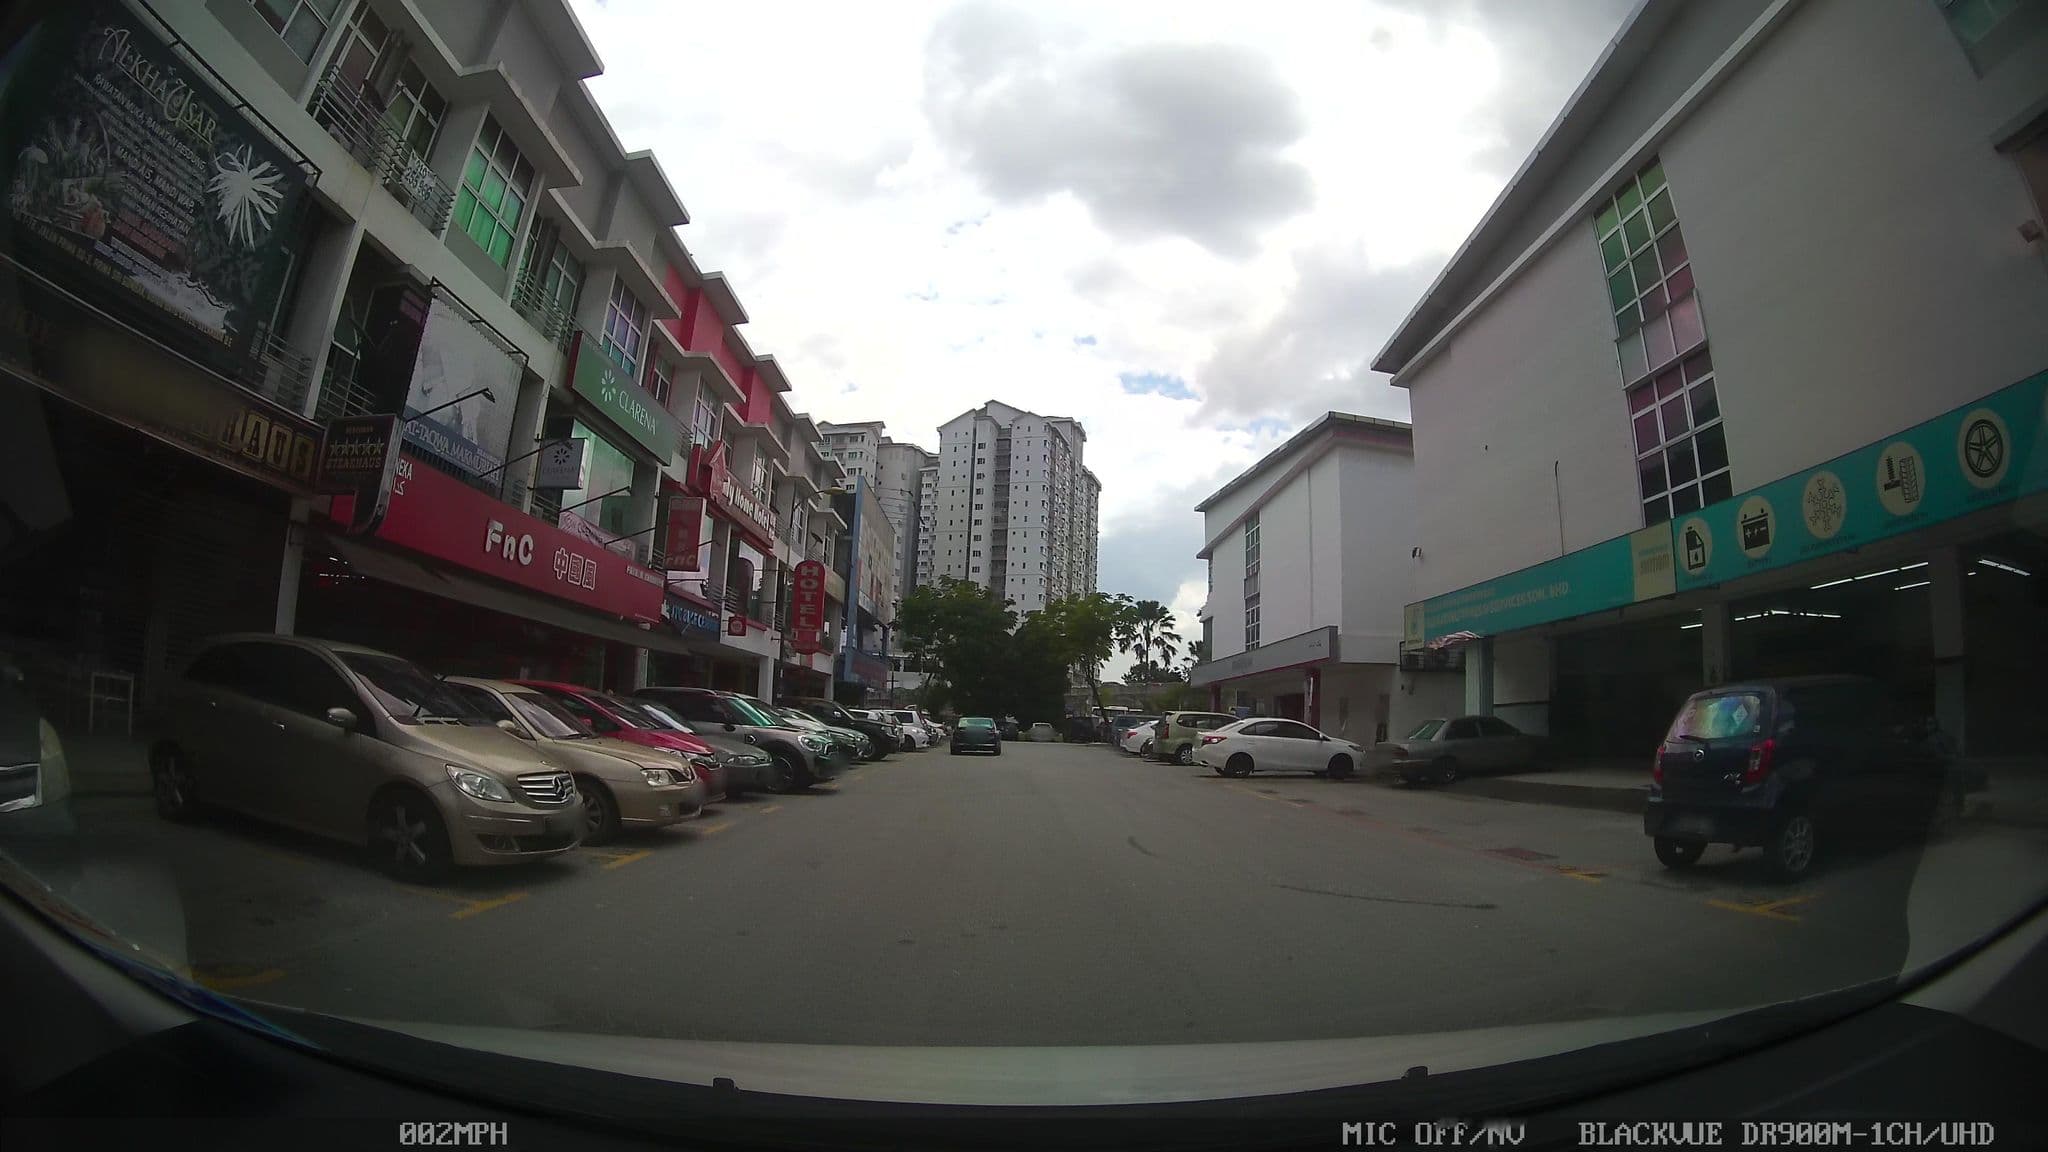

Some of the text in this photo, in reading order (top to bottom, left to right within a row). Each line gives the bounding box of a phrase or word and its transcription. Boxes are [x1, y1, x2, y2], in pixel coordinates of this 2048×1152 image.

[619, 390, 656, 436] CLARENA
[734, 485, 754, 518] Home
[485, 519, 534, 566] FnC
[799, 566, 820, 629] HOTEL
